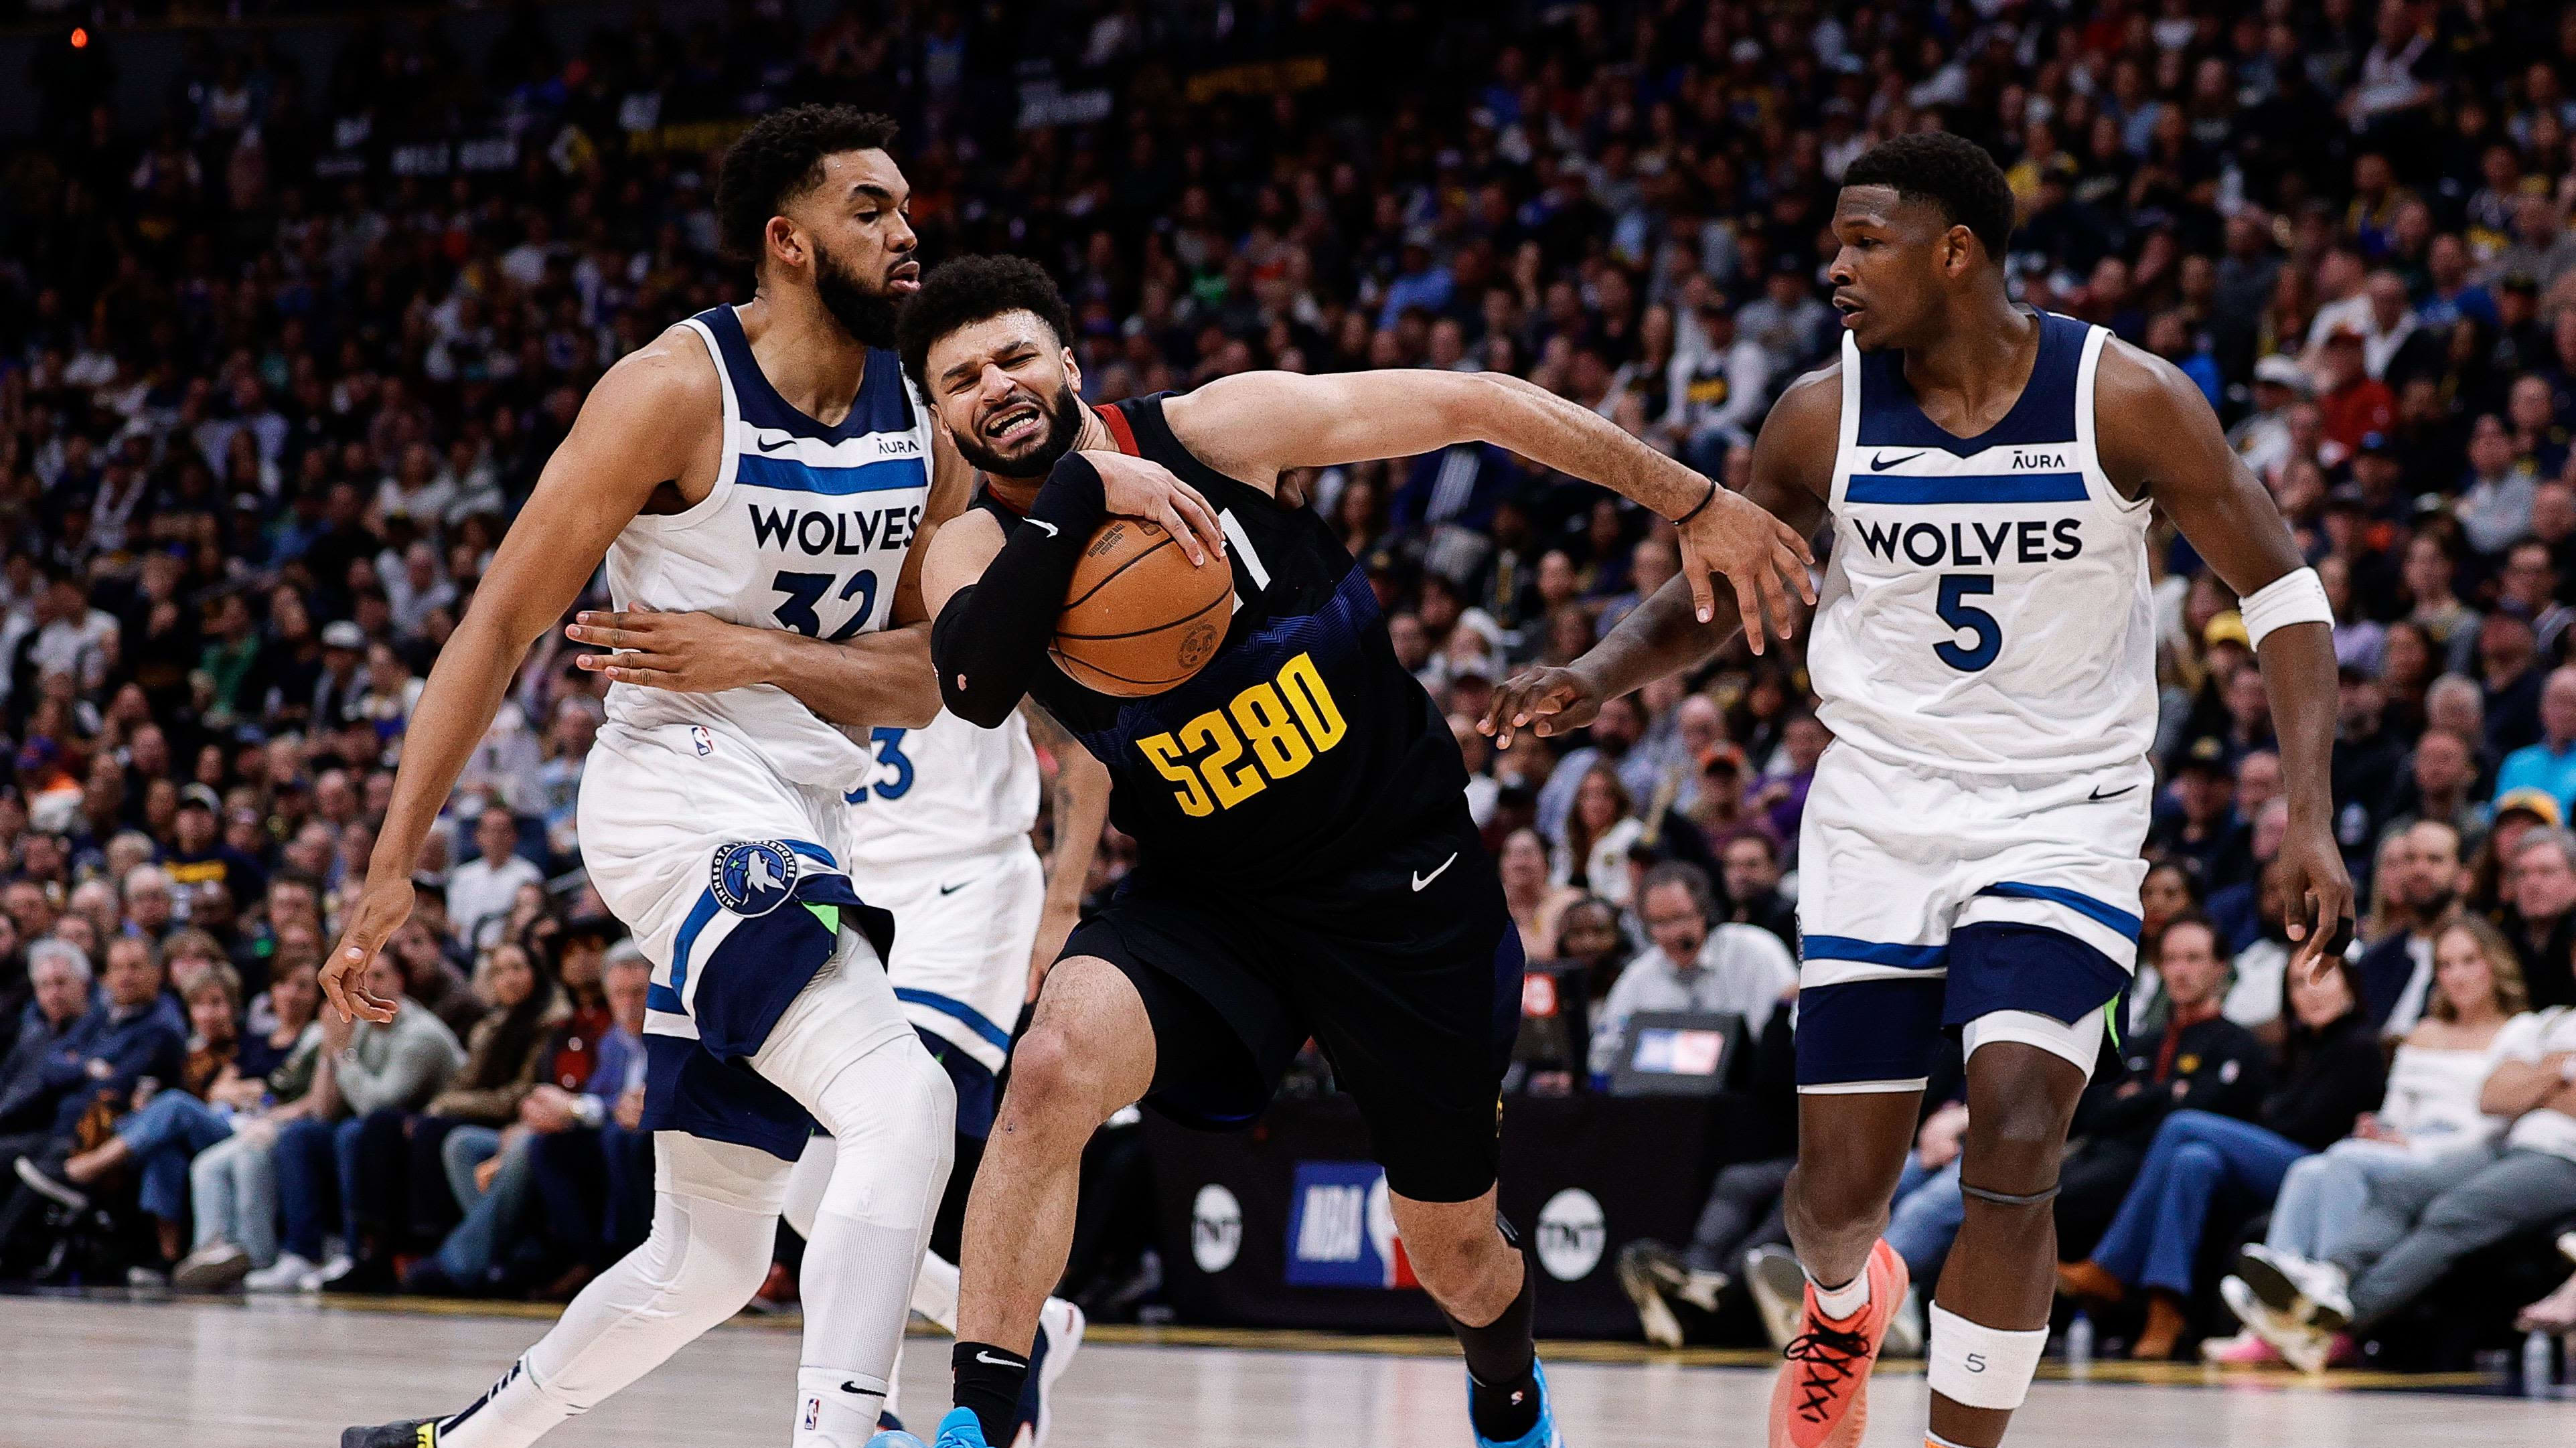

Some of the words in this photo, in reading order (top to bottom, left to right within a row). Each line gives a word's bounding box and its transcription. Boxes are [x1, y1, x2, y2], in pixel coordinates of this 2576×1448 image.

[748, 503, 920, 555] WOLVES
[1853, 518, 2082, 566] WOLVES
[772, 569, 878, 641] 32
[1933, 574, 2003, 673] 5
[1136, 651, 1347, 817] 5280
[712, 846, 735, 908] MINNESOTA
[1296, 1185, 1364, 1261] NBA
[1965, 1353, 1987, 1373] 5
